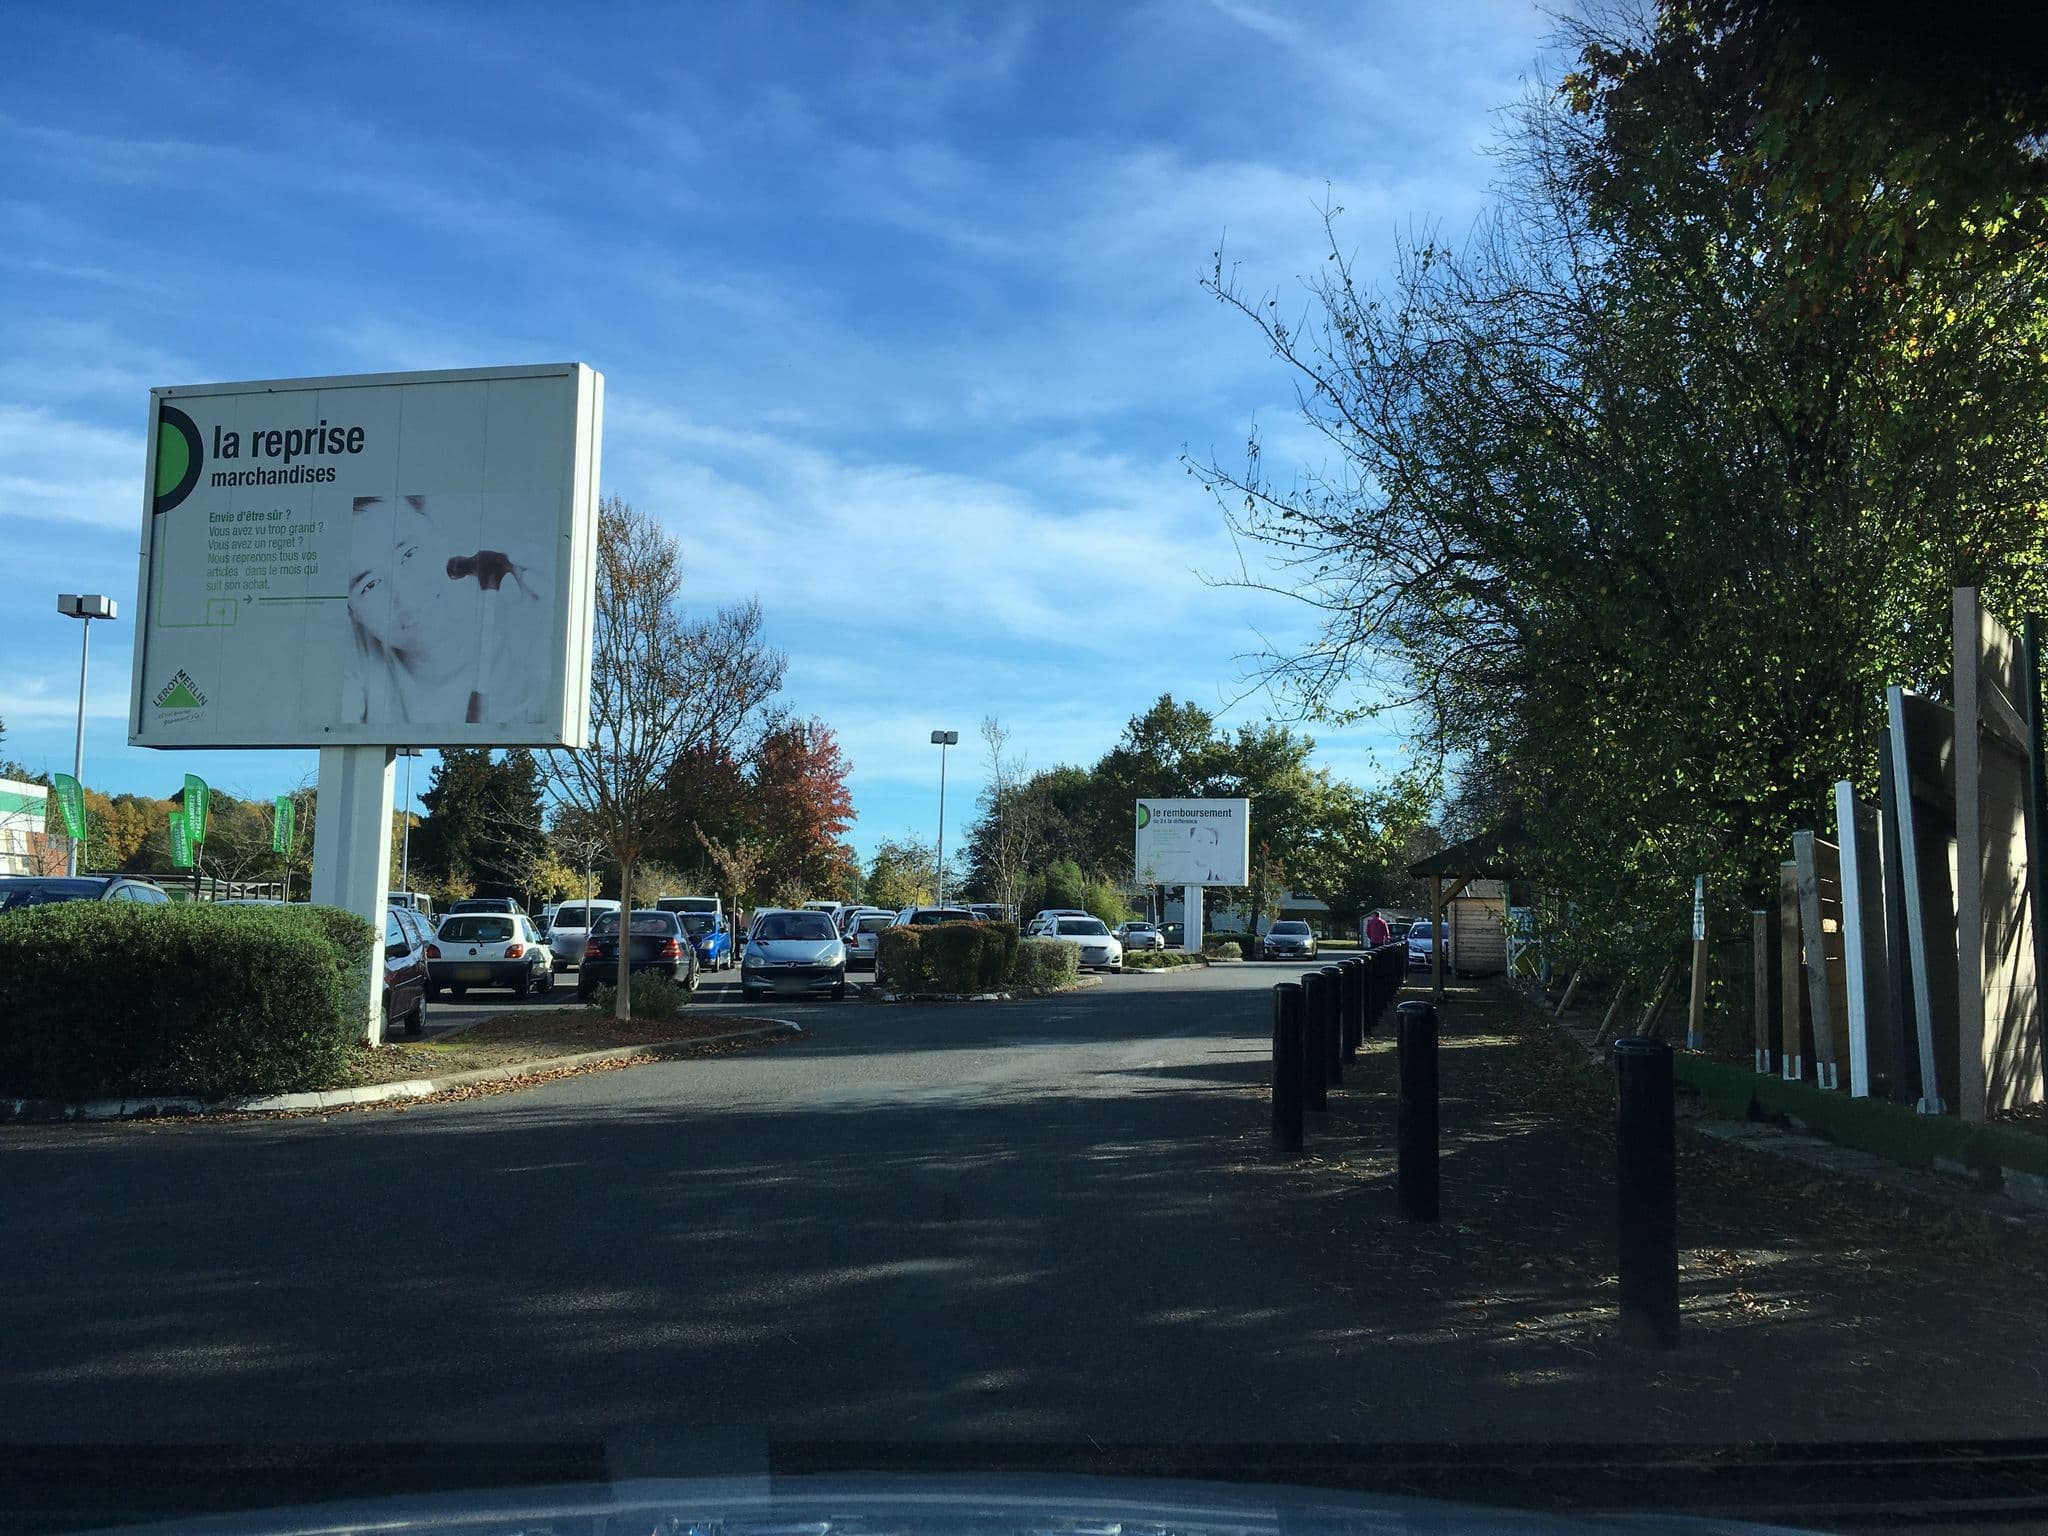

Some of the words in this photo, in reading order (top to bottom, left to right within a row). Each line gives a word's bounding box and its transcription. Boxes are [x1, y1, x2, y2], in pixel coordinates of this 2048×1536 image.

[213, 425, 240, 459] la
[252, 420, 365, 464] reprise
[211, 465, 336, 487] marchandises
[209, 511, 234, 523] Envie
[236, 510, 265, 521] d'être
[266, 509, 283, 521] sûr
[209, 526, 230, 537] Vous
[232, 526, 253, 536] avez
[255, 526, 266, 535] vu
[268, 524, 286, 537] trop
[288, 521, 315, 536] grand
[208, 539, 230, 551] Vous
[231, 540, 252, 550] avez
[254, 539, 266, 549] un
[268, 536, 295, 551] regret
[207, 552, 230, 565] Nous
[232, 552, 277, 565] reprenons
[279, 551, 299, 561] tous
[301, 551, 317, 561] vos
[207, 565, 239, 577] articles
[245, 565, 267, 577] dans
[269, 563, 278, 576] le
[280, 564, 302, 575] mois
[303, 562, 319, 577] qui
[206, 579, 222, 591] suit
[224, 580, 241, 591] son
[242, 578, 271, 590] achat.
[153, 676, 179, 707] LEROY
[176, 669, 208, 706] MERLIN
[1153, 808, 1161, 817] le
[1163, 807, 1232, 818] remboursement
